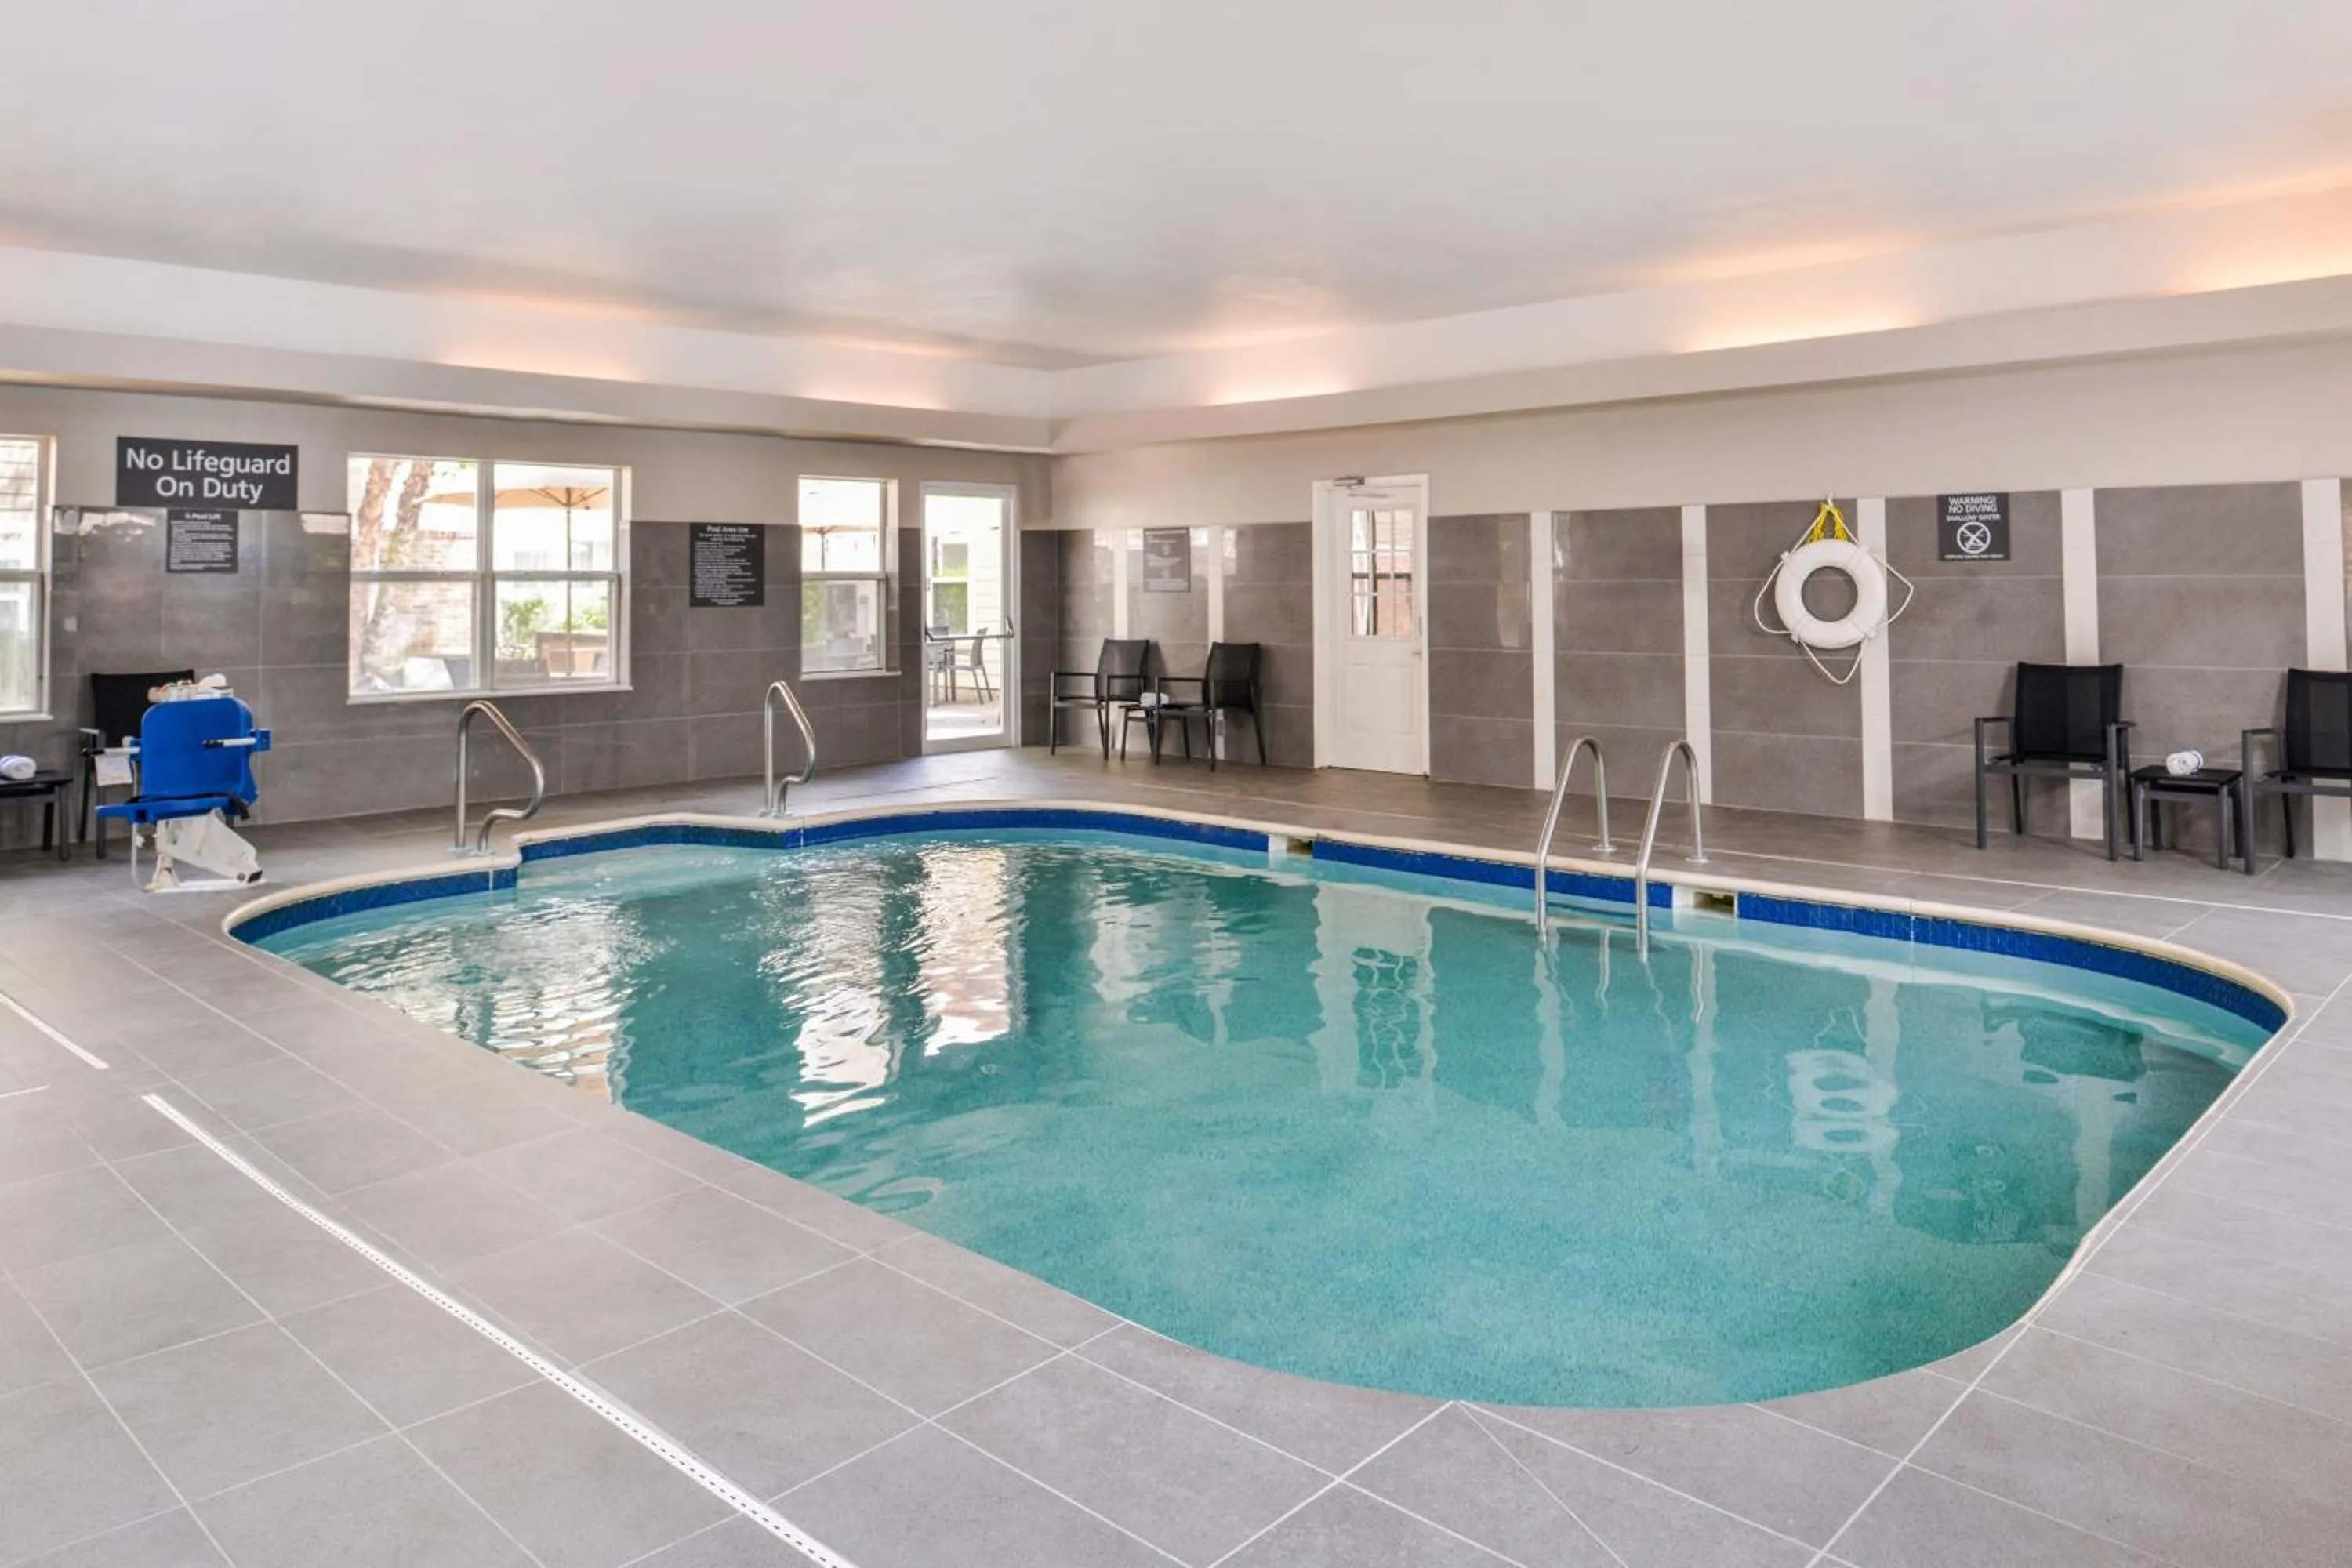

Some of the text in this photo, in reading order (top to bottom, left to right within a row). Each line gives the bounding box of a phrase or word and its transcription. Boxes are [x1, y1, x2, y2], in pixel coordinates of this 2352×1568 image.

[126, 447, 291, 478] No Lifeguard
[156, 475, 263, 504] On Duty
[1965, 504, 1997, 513] DIVING
